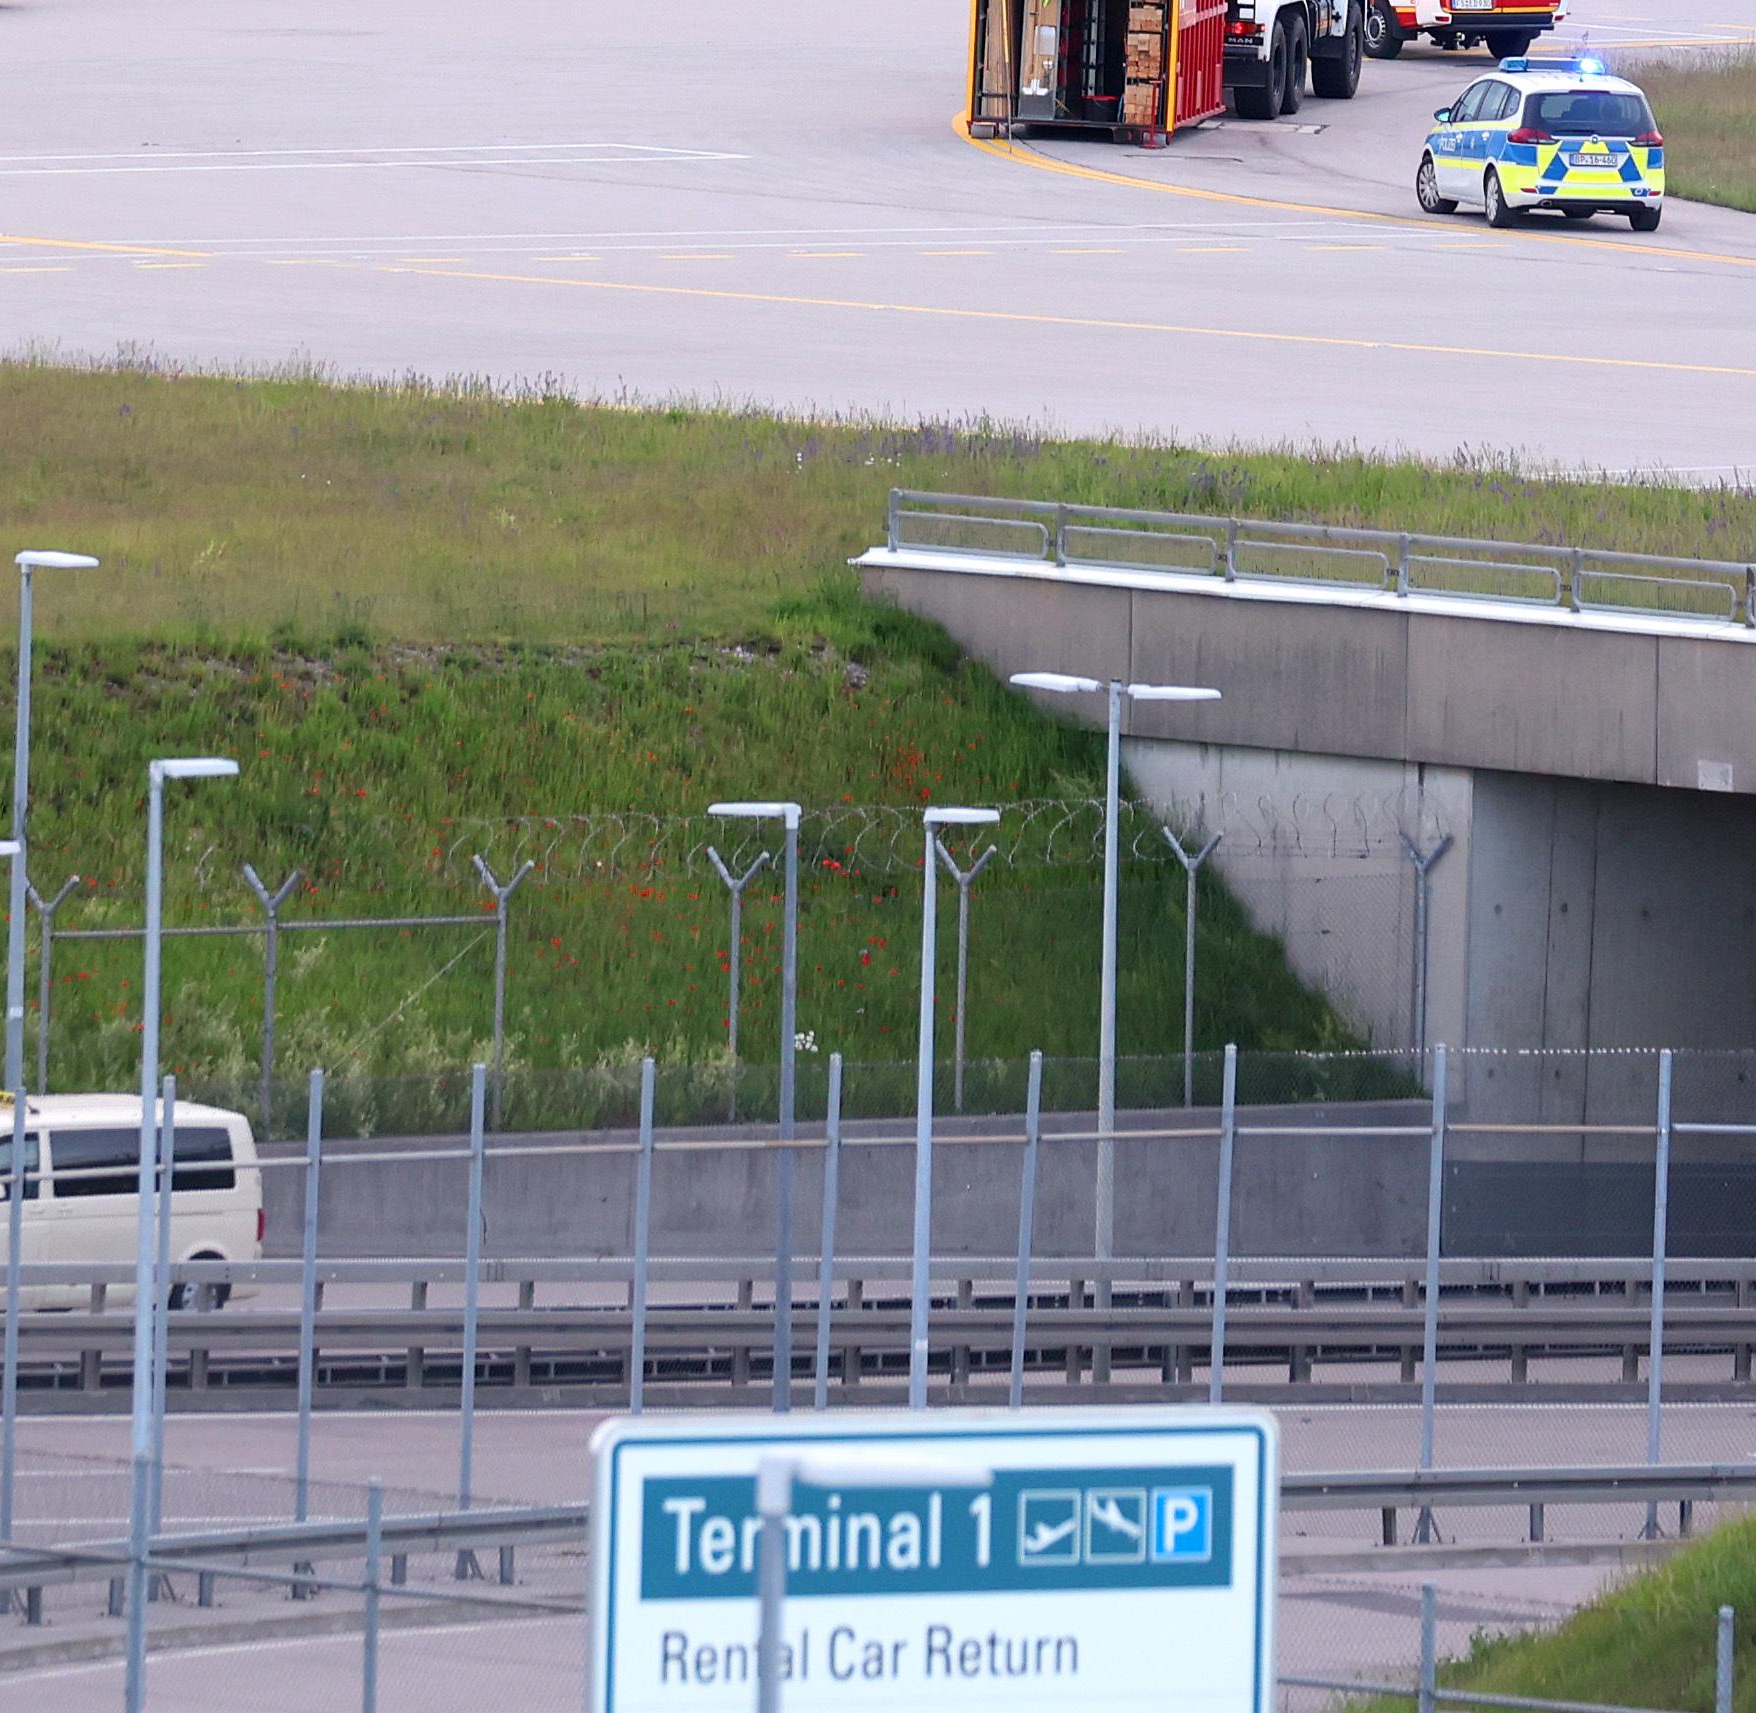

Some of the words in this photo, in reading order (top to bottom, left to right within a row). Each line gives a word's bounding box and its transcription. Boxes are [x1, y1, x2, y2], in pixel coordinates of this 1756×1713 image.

[1227, 36, 1254, 44] MAN
[662, 1491, 943, 1575] Terminal
[968, 1492, 992, 1569] 1
[660, 1628, 809, 1685] Renal
[828, 1625, 908, 1682] Car
[925, 1623, 1079, 1678] Return
